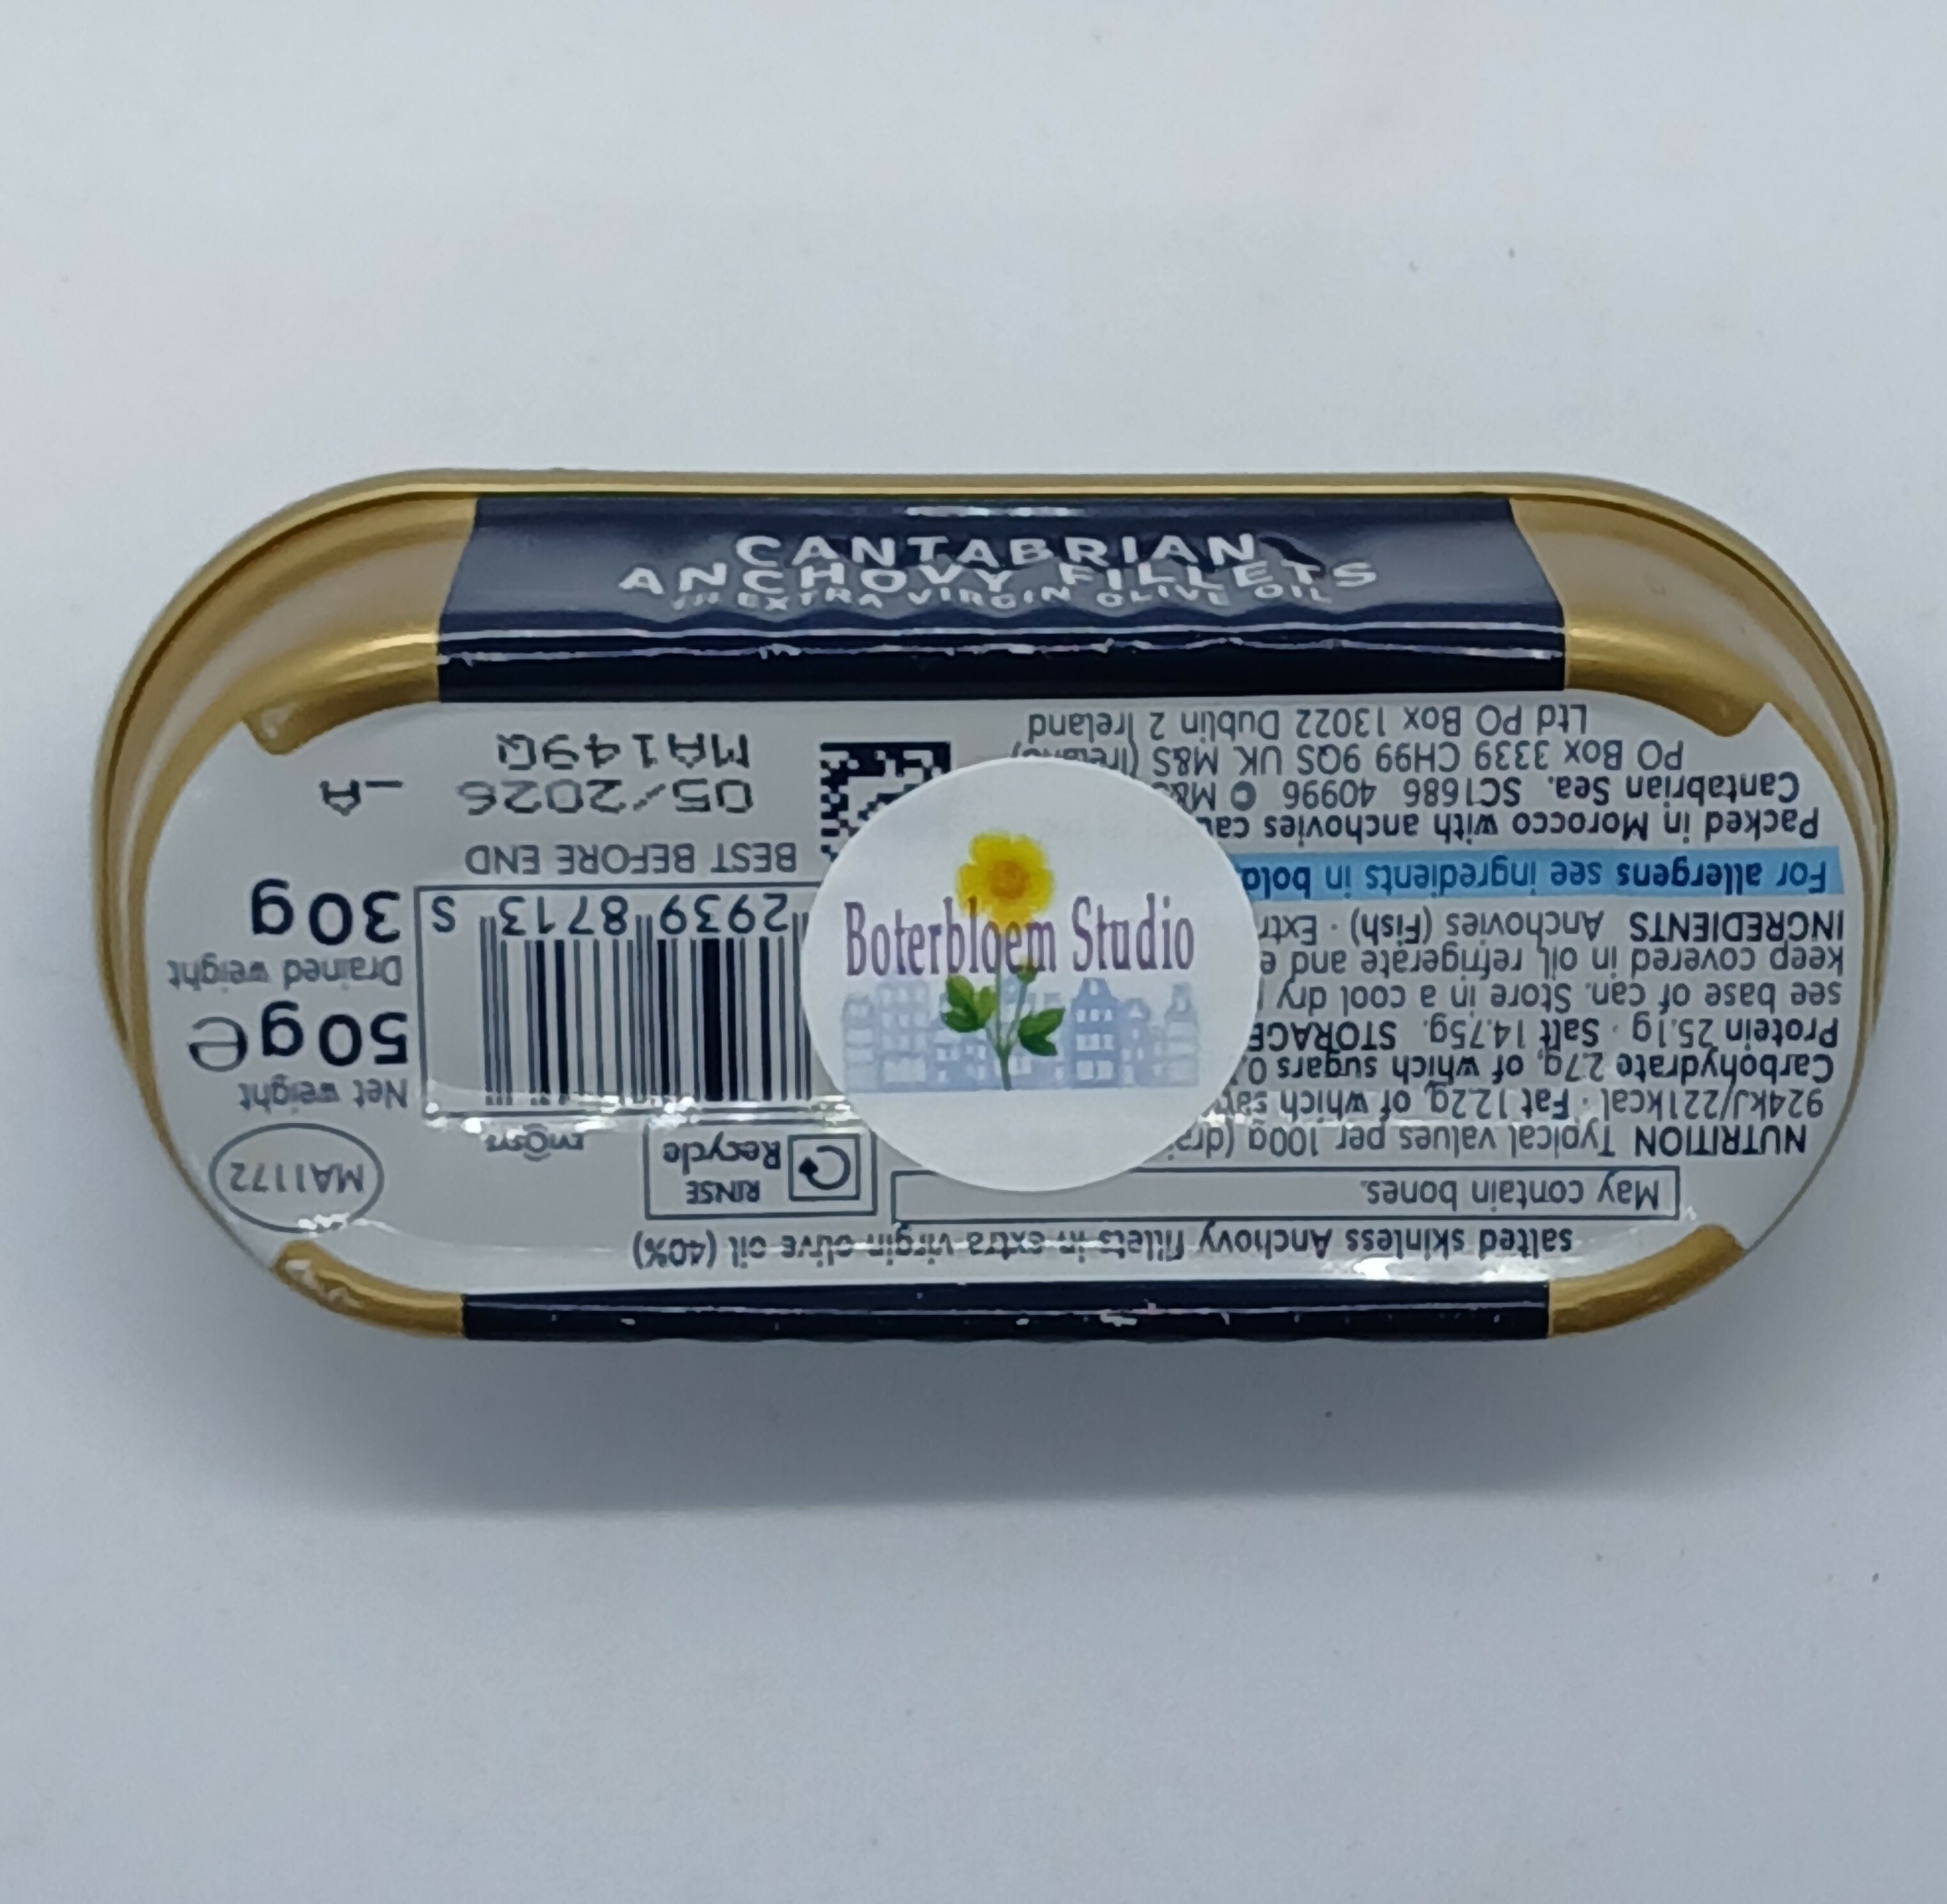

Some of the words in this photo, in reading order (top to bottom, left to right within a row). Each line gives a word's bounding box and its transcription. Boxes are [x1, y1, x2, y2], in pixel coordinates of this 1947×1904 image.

[736, 533, 1255, 567] CANTABRIAN
[618, 561, 1013, 595] ANCHOVY
[1059, 560, 1376, 590] FILLETS
[737, 586, 884, 612] EXTRA
[907, 586, 1070, 609] VIRGIN
[1096, 584, 1230, 607] OLIVE
[1255, 584, 1333, 604] OIL
[1028, 712, 1133, 745] Ireland
[1149, 712, 1166, 742] 2
[1180, 709, 1279, 744] Dublin
[1295, 707, 1386, 739] 13022
[1403, 706, 1461, 737] Box
[1476, 704, 1522, 736] PO
[1536, 703, 1587, 736] Ltd
[496, 733, 750, 770] MA149Q
[1152, 746, 1218, 777] M&S
[1232, 744, 1282, 776] UK
[1295, 743, 1361, 776] 9QS
[1375, 742, 1460, 773] CH99
[1474, 739, 1551, 771] 3339
[1563, 740, 1623, 770] Box
[1637, 740, 1684, 770] PO
[455, 777, 753, 815] 05/2026
[1282, 777, 1377, 809] 40996
[1402, 775, 1522, 809] SC1686
[1547, 775, 1611, 806] Sea.
[1626, 772, 1800, 808] Cantabrian
[1264, 813, 1419, 848] anchovies
[1434, 813, 1498, 845] with
[1512, 810, 1649, 841] Morocco
[1663, 810, 1690, 844] in
[1704, 808, 1819, 843] Packed
[464, 844, 540, 875] END
[554, 843, 695, 875] BEFORE
[710, 842, 797, 874] BEST
[1550, 861, 1602, 887] see
[1325, 866, 1351, 899] in
[1364, 855, 1536, 898] ingredients
[1616, 856, 1762, 896] allergens
[1776, 861, 1827, 894] For
[251, 878, 401, 946] 30g
[431, 895, 456, 933] S
[497, 894, 629, 936] 8713
[659, 893, 788, 935] 2939
[1350, 907, 1432, 947] (Fish)
[1445, 910, 1604, 945] Anchovies
[1629, 910, 1844, 942] INGREDIENTS
[843, 895, 1058, 977] Boterbloem
[1072, 892, 1194, 974] Studio
[1258, 914, 1317, 946] Extr
[166, 952, 270, 992] weight
[283, 955, 403, 991] Drained
[1291, 951, 1347, 982] and
[1360, 944, 1522, 981] refrigerate
[1591, 946, 1618, 979] in
[1630, 946, 1755, 979] covered
[1769, 940, 1843, 977] keep
[1276, 977, 1327, 1017] dry
[1340, 985, 1406, 1017] cool
[1419, 985, 1436, 1008] a
[1450, 984, 1474, 1017] in
[1490, 983, 1572, 1015] Store
[1584, 982, 1646, 1006] can.
[1659, 983, 1690, 1015] of
[1704, 982, 1776, 1014] base
[1790, 981, 1841, 1008] see
[260, 1000, 409, 1068] 50g
[1247, 1020, 1397, 1051] STORAGE
[1423, 1012, 1525, 1050] 14.75g.
[1539, 1018, 1599, 1049] Salt
[1632, 1011, 1714, 1049] 25.1g
[1725, 1017, 1838, 1050] Protein
[1229, 1054, 1267, 1086] 0.
[1276, 1049, 1377, 1081] sugars
[1391, 1054, 1479, 1085] which
[1492, 1054, 1524, 1085] of
[1616, 1046, 1834, 1086] Carbohydrate
[237, 1074, 341, 1114] weight
[352, 1078, 409, 1111] Net
[1280, 1090, 1368, 1123] which
[1379, 1089, 1411, 1122] of
[1521, 1088, 1570, 1121] Fat
[1600, 1077, 1824, 1121] 924kJ/221kcal
[1248, 1119, 1319, 1159] 100g
[1335, 1119, 1385, 1151] per
[1399, 1125, 1496, 1159] values
[1508, 1117, 1616, 1159] Typical
[1634, 1124, 1807, 1158] NUTRITION
[662, 1131, 781, 1176] Recycle
[229, 1162, 364, 1194] MA1172
[685, 1180, 760, 1205] RINSE
[1597, 1171, 1659, 1211] May
[1360, 1180, 1458, 1212] bones.
[1471, 1180, 1584, 1212] contain
[632, 1229, 717, 1270] (40%)
[728, 1235, 767, 1268] oil
[780, 1235, 852, 1268] olive
[866, 1222, 953, 1266] virgin
[966, 1230, 1045, 1261] extra
[1059, 1230, 1085, 1265] in
[1098, 1229, 1184, 1263] fillets
[1199, 1221, 1332, 1260] Anchovy
[1345, 1228, 1465, 1260] skinless
[1478, 1228, 1573, 1261] salted
